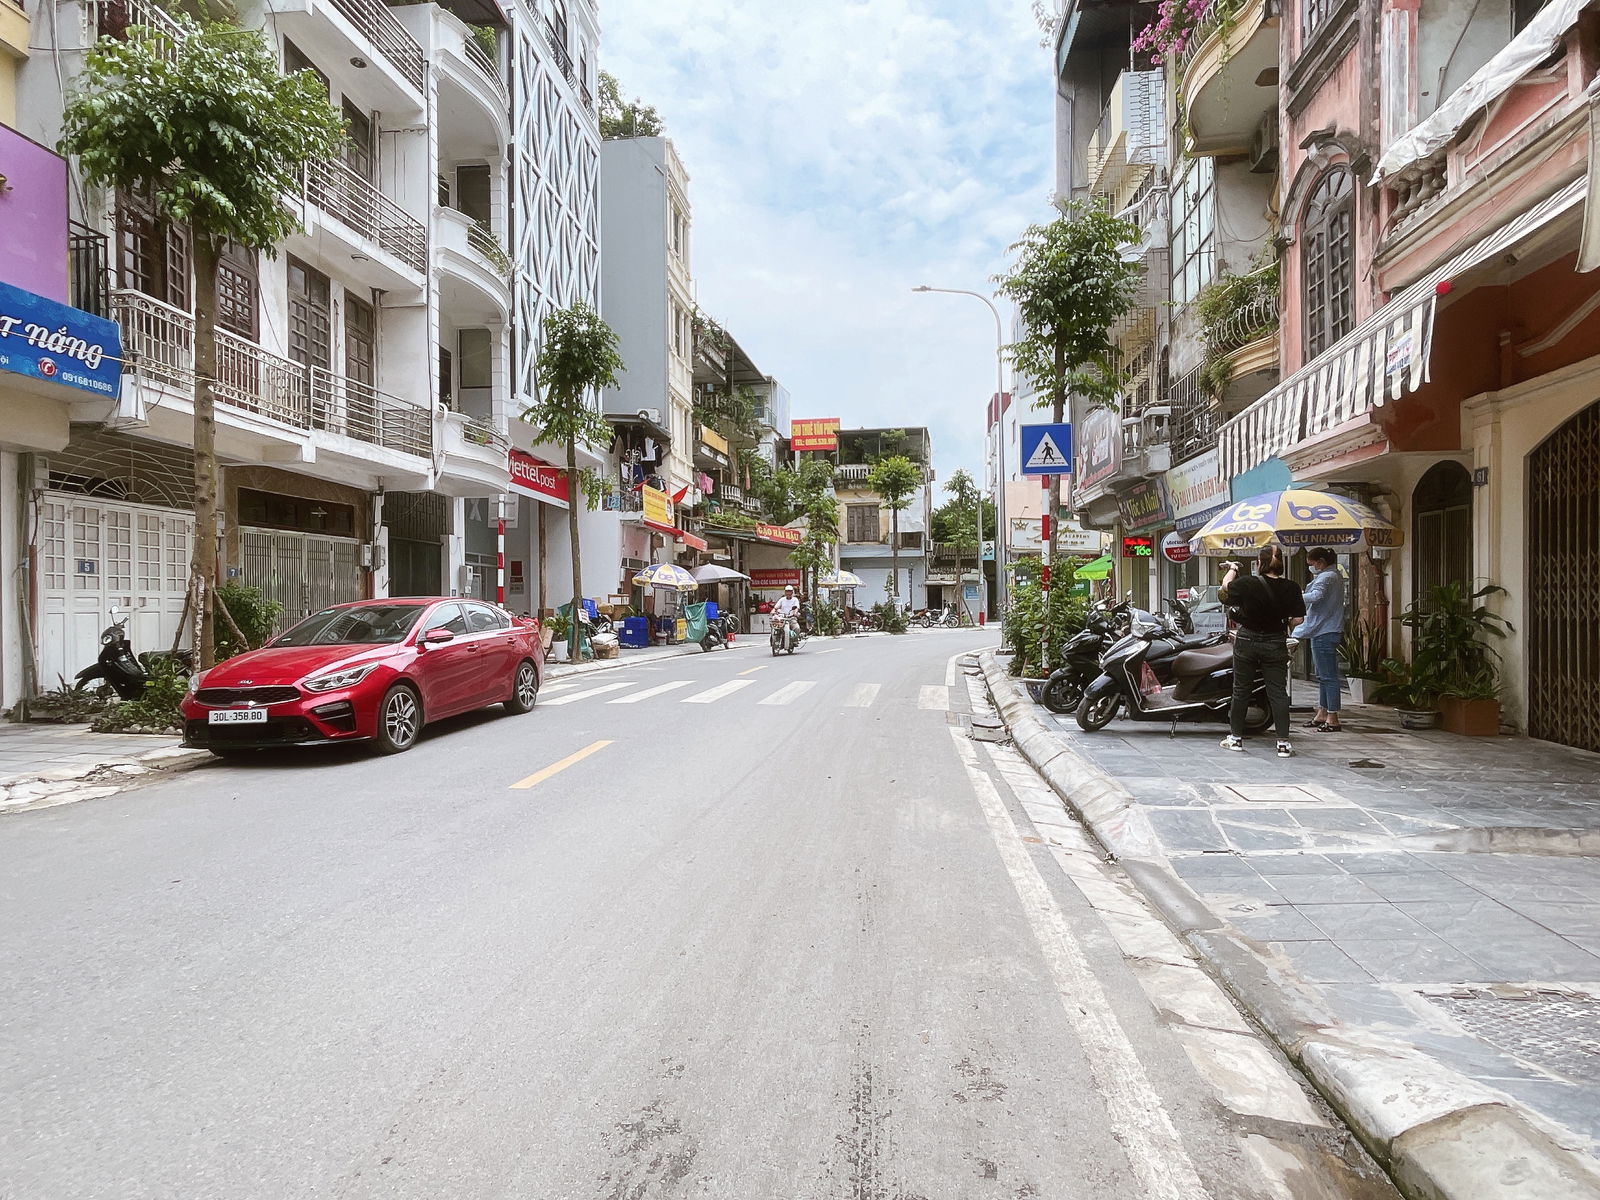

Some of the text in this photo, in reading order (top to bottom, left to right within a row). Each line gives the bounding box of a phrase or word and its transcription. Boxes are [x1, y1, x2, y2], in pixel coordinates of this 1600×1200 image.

[540, 473, 556, 489] post
[1232, 502, 1272, 522] be
[1287, 501, 1338, 521] be
[1223, 522, 1260, 533] GIAO
[1283, 532, 1309, 544] SIÊU
[1369, 529, 1392, 545] 50%
[1134, 544, 1152, 556] Tóc
[84, 562, 90, 572] 5
[230, 569, 236, 577] 7
[213, 711, 262, 721] 30L-358.80
